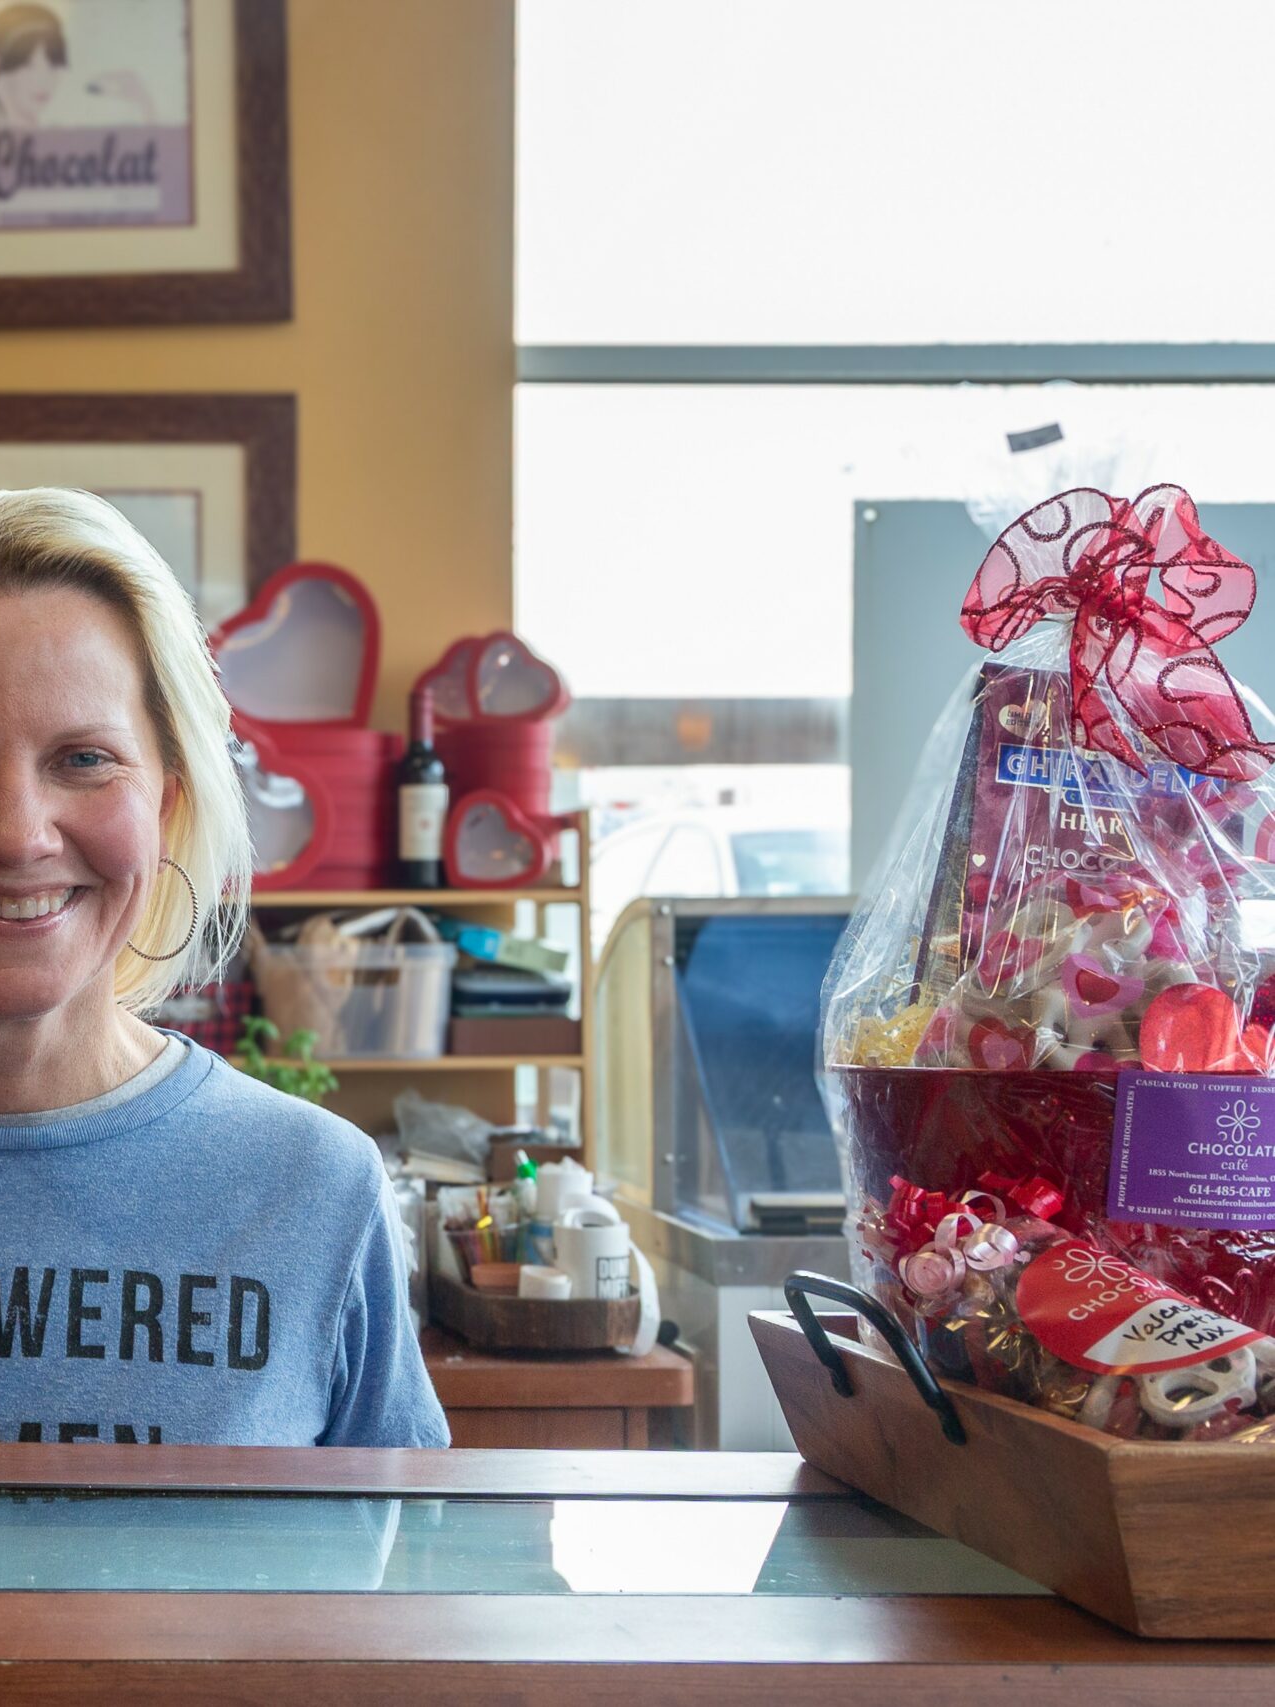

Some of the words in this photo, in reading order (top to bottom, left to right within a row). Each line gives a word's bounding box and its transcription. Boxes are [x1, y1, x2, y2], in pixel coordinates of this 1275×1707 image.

[1006, 752, 1218, 794] GHRADEL
[1136, 1079, 1171, 1089] CASUAL
[1173, 1082, 1199, 1091] FOOD
[1208, 1084, 1242, 1093] COFFEE
[1117, 1174, 1128, 1207] PEOPLE
[1123, 1090, 1135, 1147] CHOCOLATES
[1221, 1159, 1249, 1171] café
[1149, 1168, 1167, 1177] 1855
[1168, 1170, 1208, 1180] Northwest
[1189, 1184, 1272, 1197] 614-485-CAFE
[1136, 1206, 1173, 1216] SPIRITS
[1180, 1209, 1223, 1219] DESSERTS
